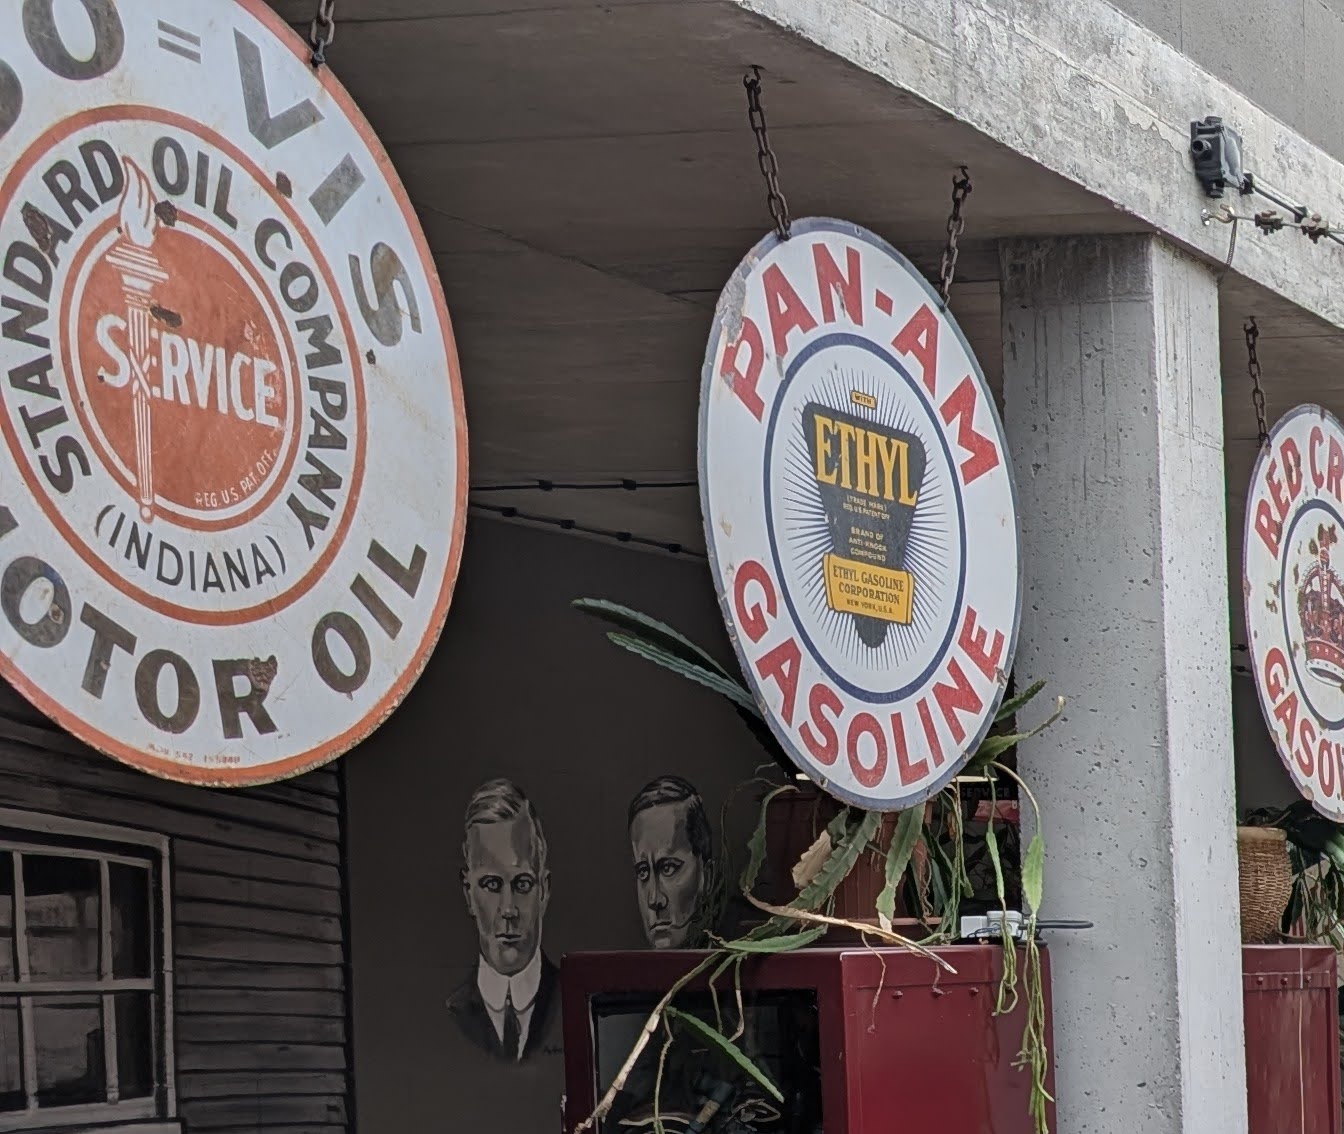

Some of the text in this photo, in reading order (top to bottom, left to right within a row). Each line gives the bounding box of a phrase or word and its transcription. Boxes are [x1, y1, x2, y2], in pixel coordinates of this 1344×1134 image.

[0, 0, 424, 347] O=VIS
[2, 136, 348, 551] STANDARD OIL COMPANY
[720, 242, 1000, 486] PAN-AM
[813, 414, 918, 507] ETHYL
[1254, 437, 1303, 558] RED
[94, 504, 286, 593] (INDIANA)
[833, 565, 904, 592] ETHYL GASOLINE
[838, 582, 900, 605] CORPORATION
[0, 506, 428, 739] OTOR OIL
[734, 560, 1005, 788] GASOLINE
[961, 787, 1011, 797] SERVCE
